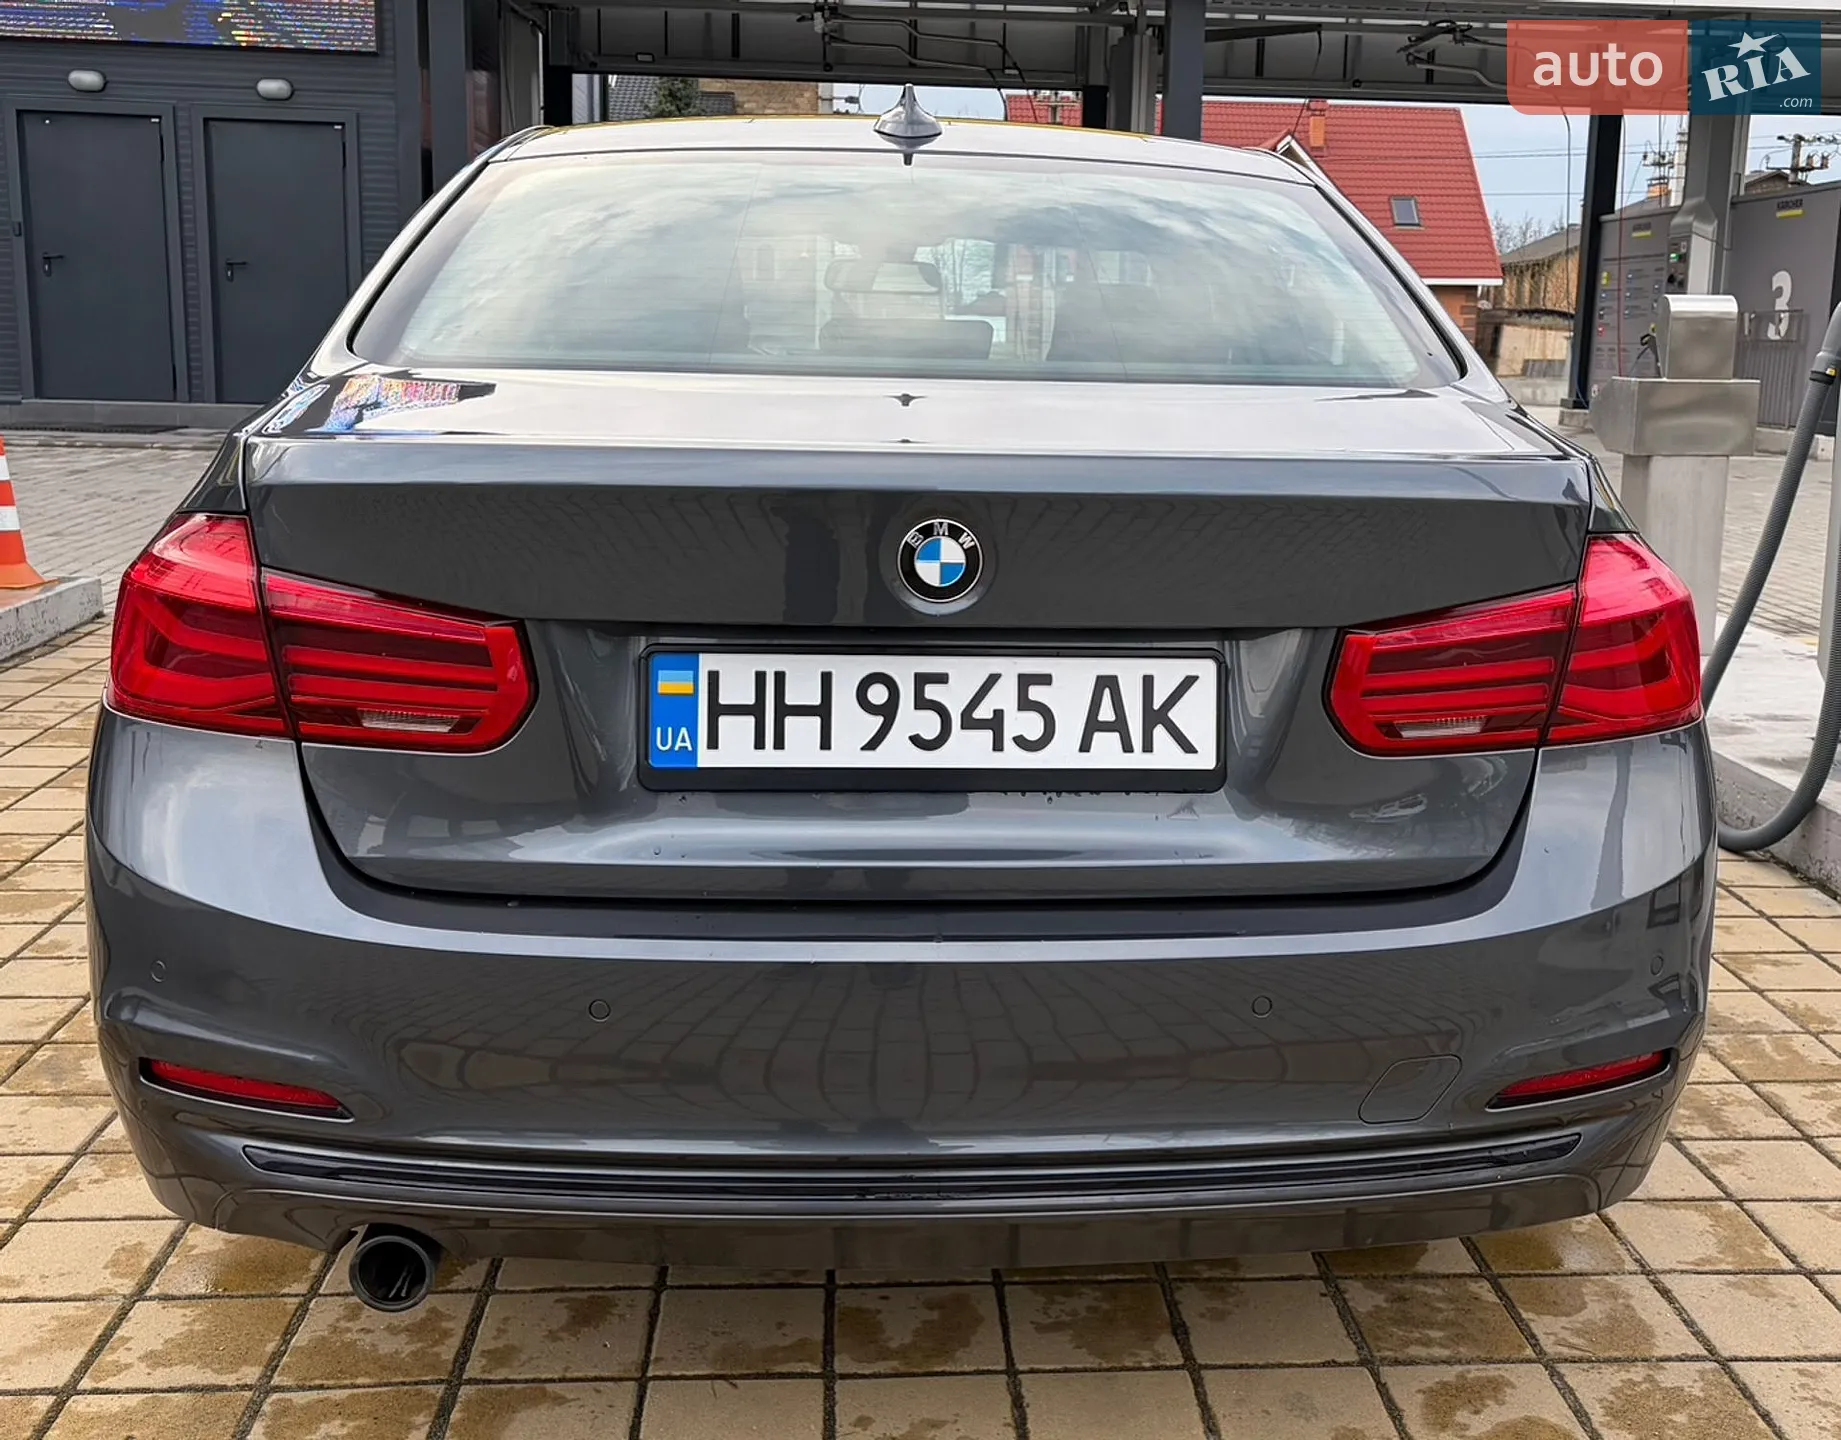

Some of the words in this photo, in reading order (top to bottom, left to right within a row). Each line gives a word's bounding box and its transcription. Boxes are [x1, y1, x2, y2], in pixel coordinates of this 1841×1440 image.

[1767, 270, 1792, 341] 3
[906, 521, 976, 550] BMW
[706, 669, 833, 751] HH
[855, 671, 1057, 752] 9545
[1077, 674, 1200, 754] AK
[655, 726, 693, 751] UA
